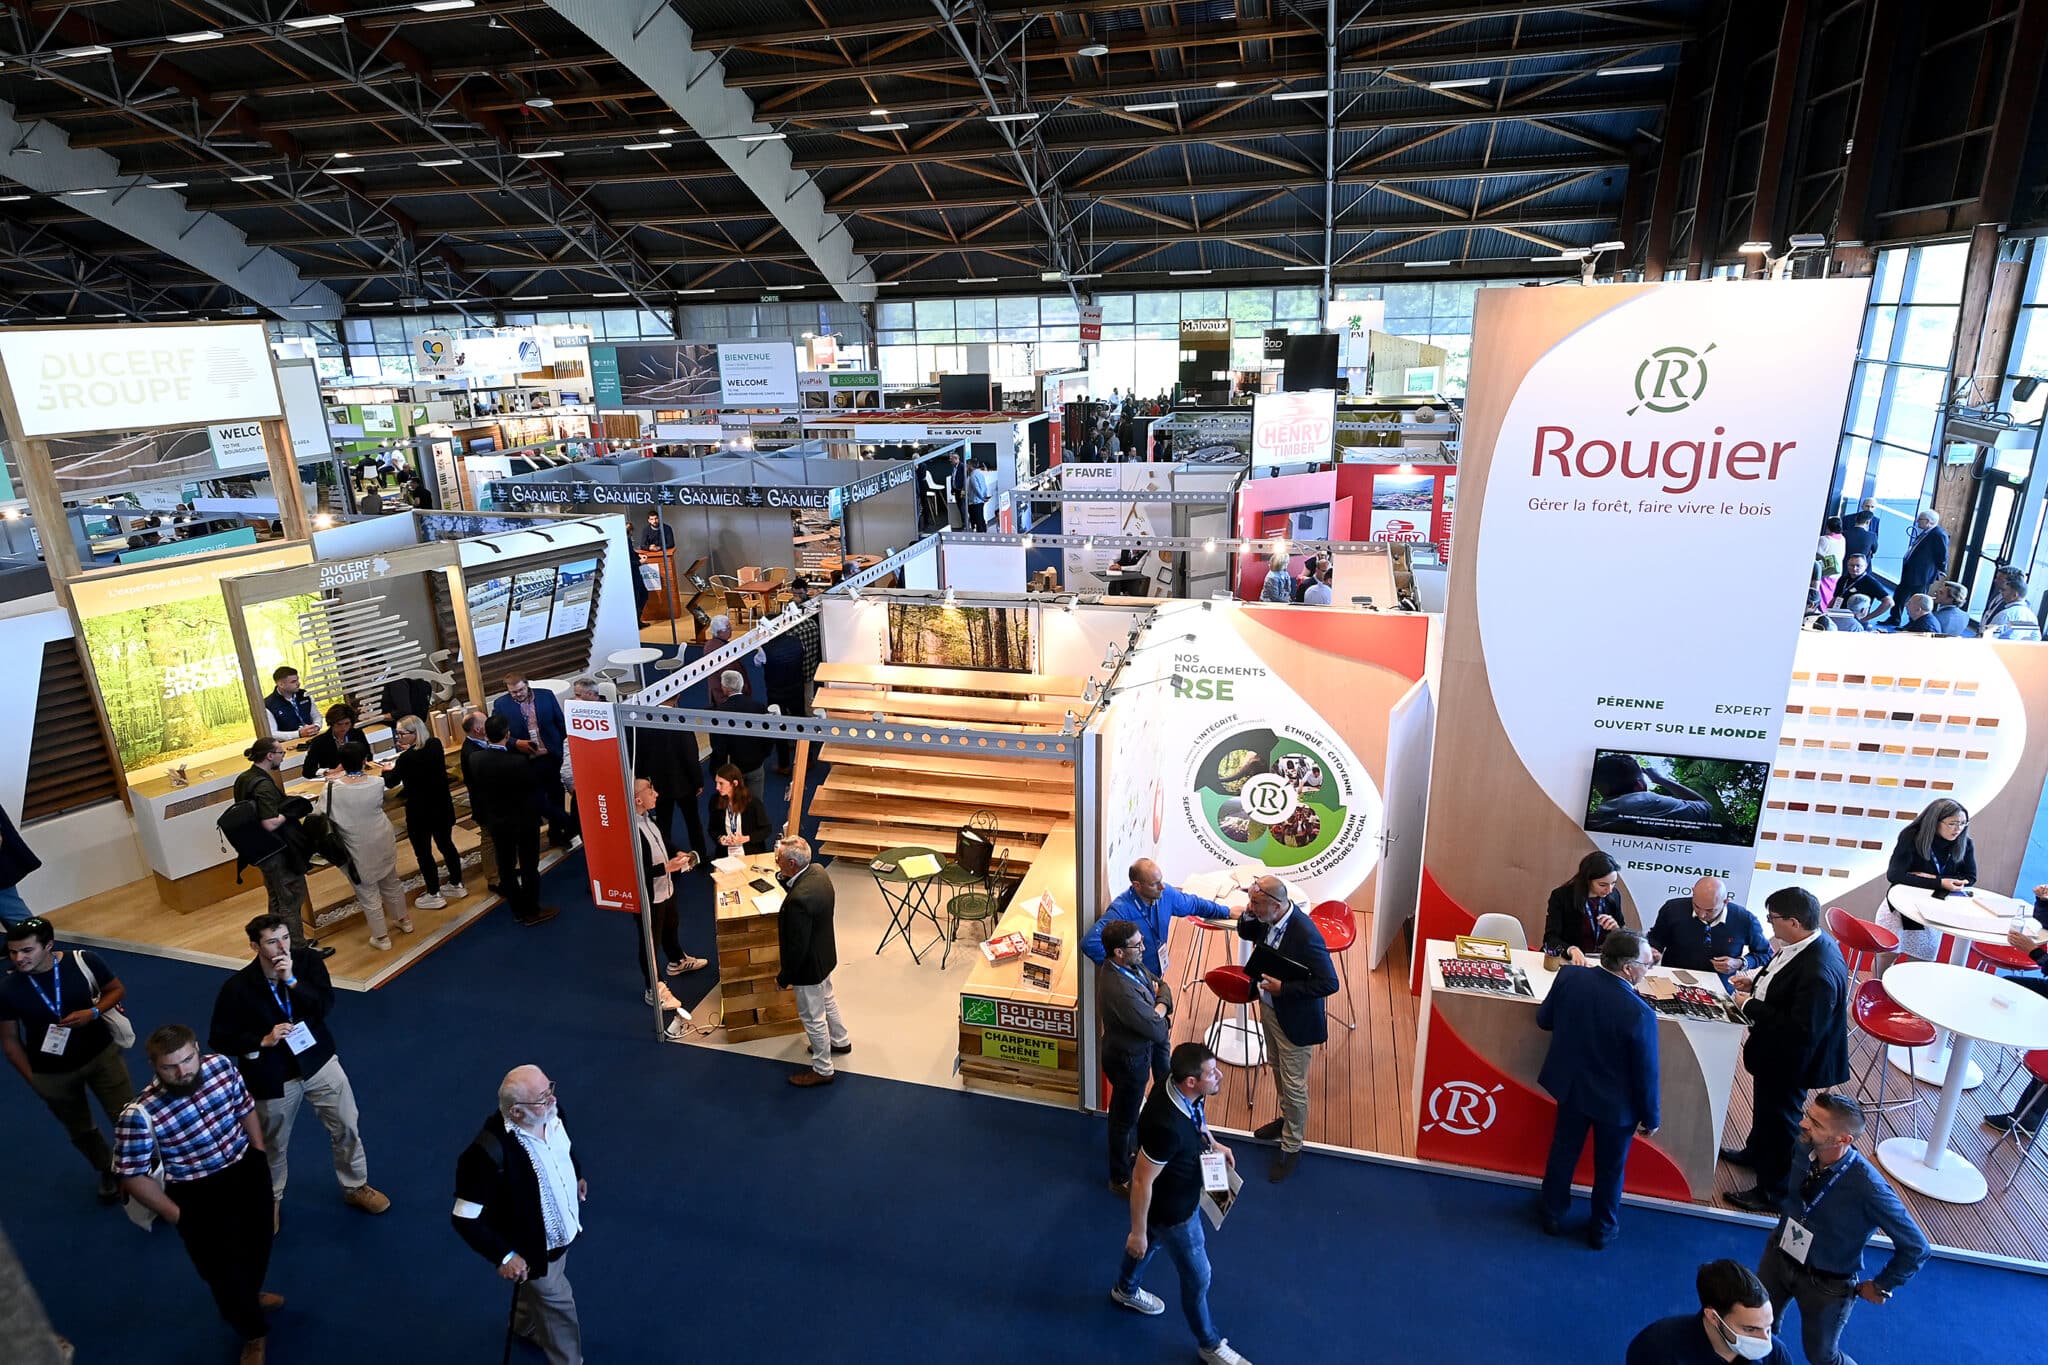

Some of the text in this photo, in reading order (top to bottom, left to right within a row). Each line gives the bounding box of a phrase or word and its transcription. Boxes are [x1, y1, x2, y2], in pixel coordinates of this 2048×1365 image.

[1182, 321, 1227, 331] Malvaux
[41, 347, 195, 380] DUCERF
[725, 353, 771, 361] BIENVENUE
[37, 376, 192, 411] GROUPE
[1265, 423, 1323, 445] HENRY
[1273, 442, 1315, 457] TIMBER
[1530, 425, 1797, 495] Rougier
[889, 469, 914, 488] GARMIER
[1075, 468, 1113, 477] FAVRE
[512, 485, 571, 502] GARMIER
[593, 486, 654, 504] GARMIER
[679, 487, 743, 507] GARMIER
[852, 482, 880, 502] GARMIER
[1528, 497, 1772, 516] Gérer la forêt, faire vivre le bois
[1378, 533, 1421, 542] HENRY
[321, 559, 371, 579] DUCERF
[319, 571, 369, 588] GROUPE
[1174, 653, 1200, 663] NOS
[1174, 664, 1266, 677] ENGAGEMENTS
[1173, 678, 1234, 702] RSE
[1597, 695, 1665, 710] PÉRENNE
[1715, 704, 1771, 717] EXPERT
[572, 718, 610, 732] BOIS
[1594, 719, 1768, 740] OUVERT SUR LE MONDE
[1327, 751, 1353, 797] CITOYENNE
[598, 794, 609, 827] ROGER
[1183, 796, 1200, 834] SERVICES
[1298, 863, 1310, 873] LE
[1310, 845, 1341, 869] CAPITAL
[1339, 814, 1357, 846] HUMAIN
[1312, 867, 1324, 877] LE
[1351, 813, 1368, 844] SOCIAL
[1612, 838, 1693, 854] HUMANISTE
[1627, 861, 1730, 880] RESPONSABLE
[1001, 1005, 1071, 1022] SCIERIES
[1001, 1014, 1072, 1033] ROGER
[984, 1031, 1055, 1051] CHARPENTE
